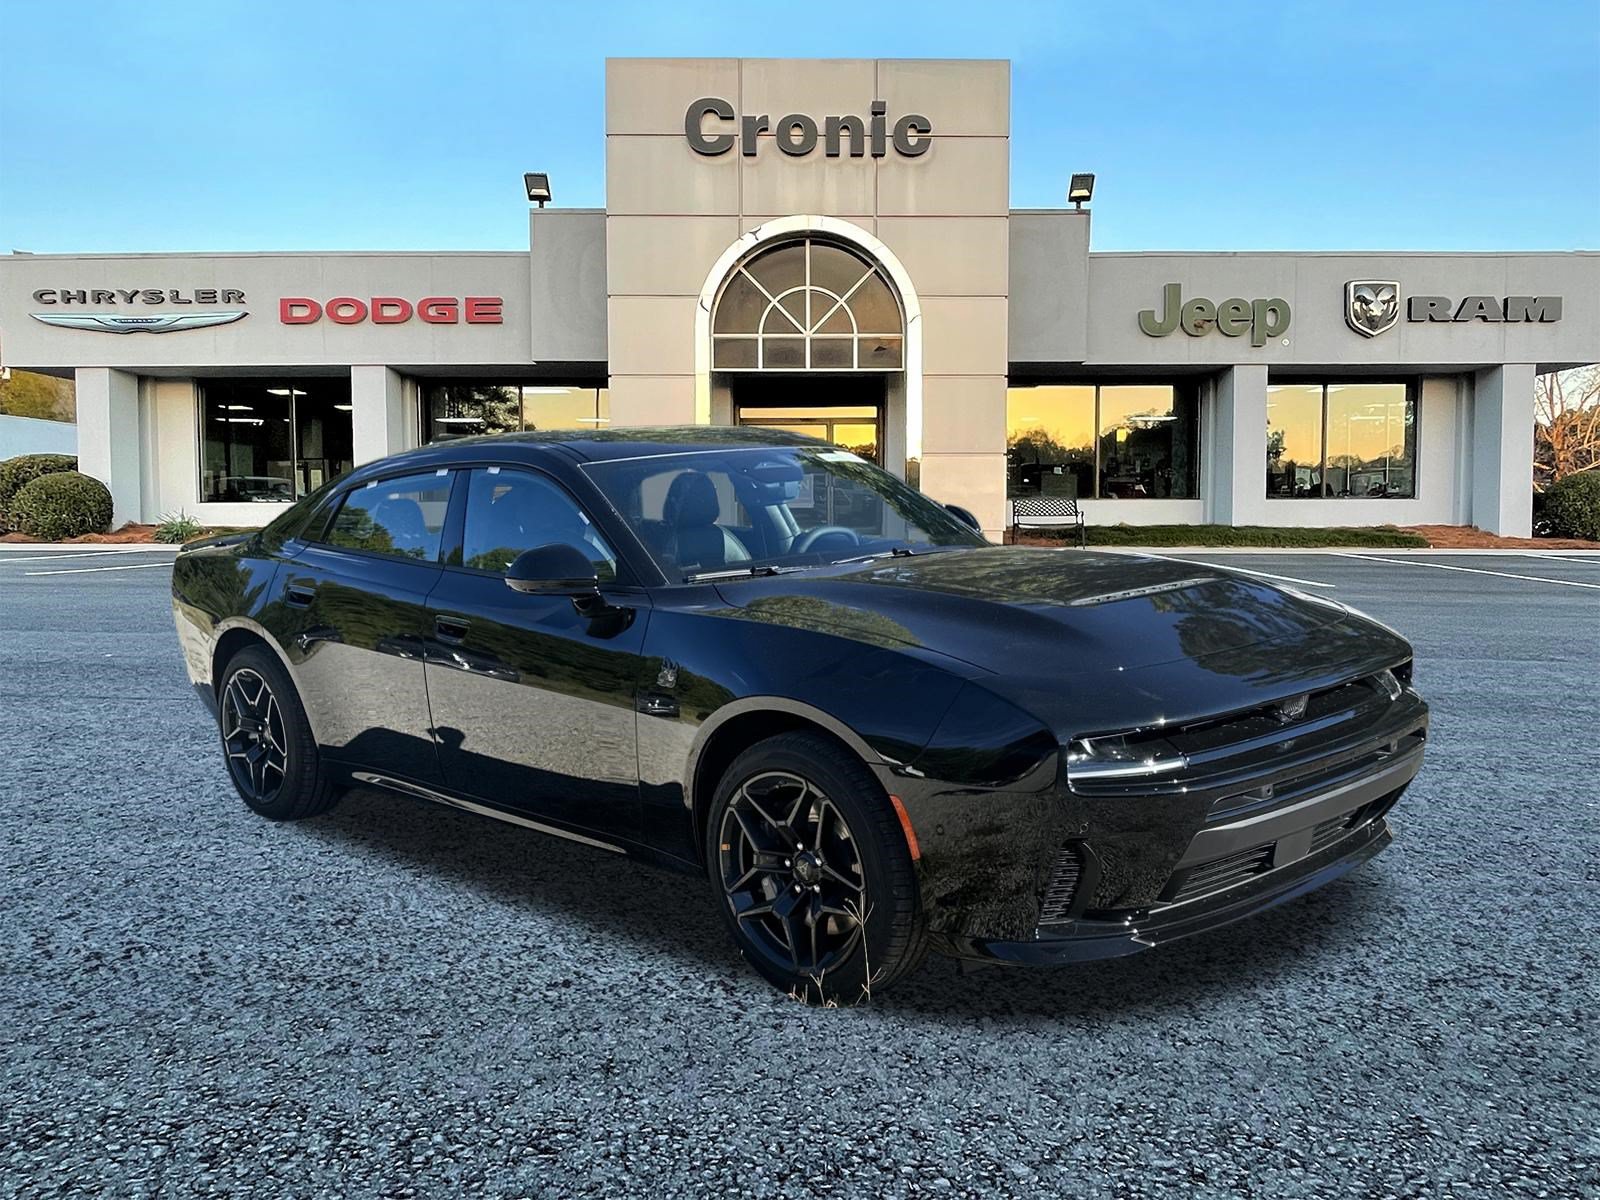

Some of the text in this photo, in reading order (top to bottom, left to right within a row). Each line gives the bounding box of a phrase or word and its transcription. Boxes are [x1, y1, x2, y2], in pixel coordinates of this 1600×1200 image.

[685, 97, 932, 157] Cronic
[32, 289, 247, 305] CHRYSLER
[280, 297, 503, 325] DODGE
[1407, 296, 1562, 323] RAM
[1138, 283, 1291, 347] Jeep
